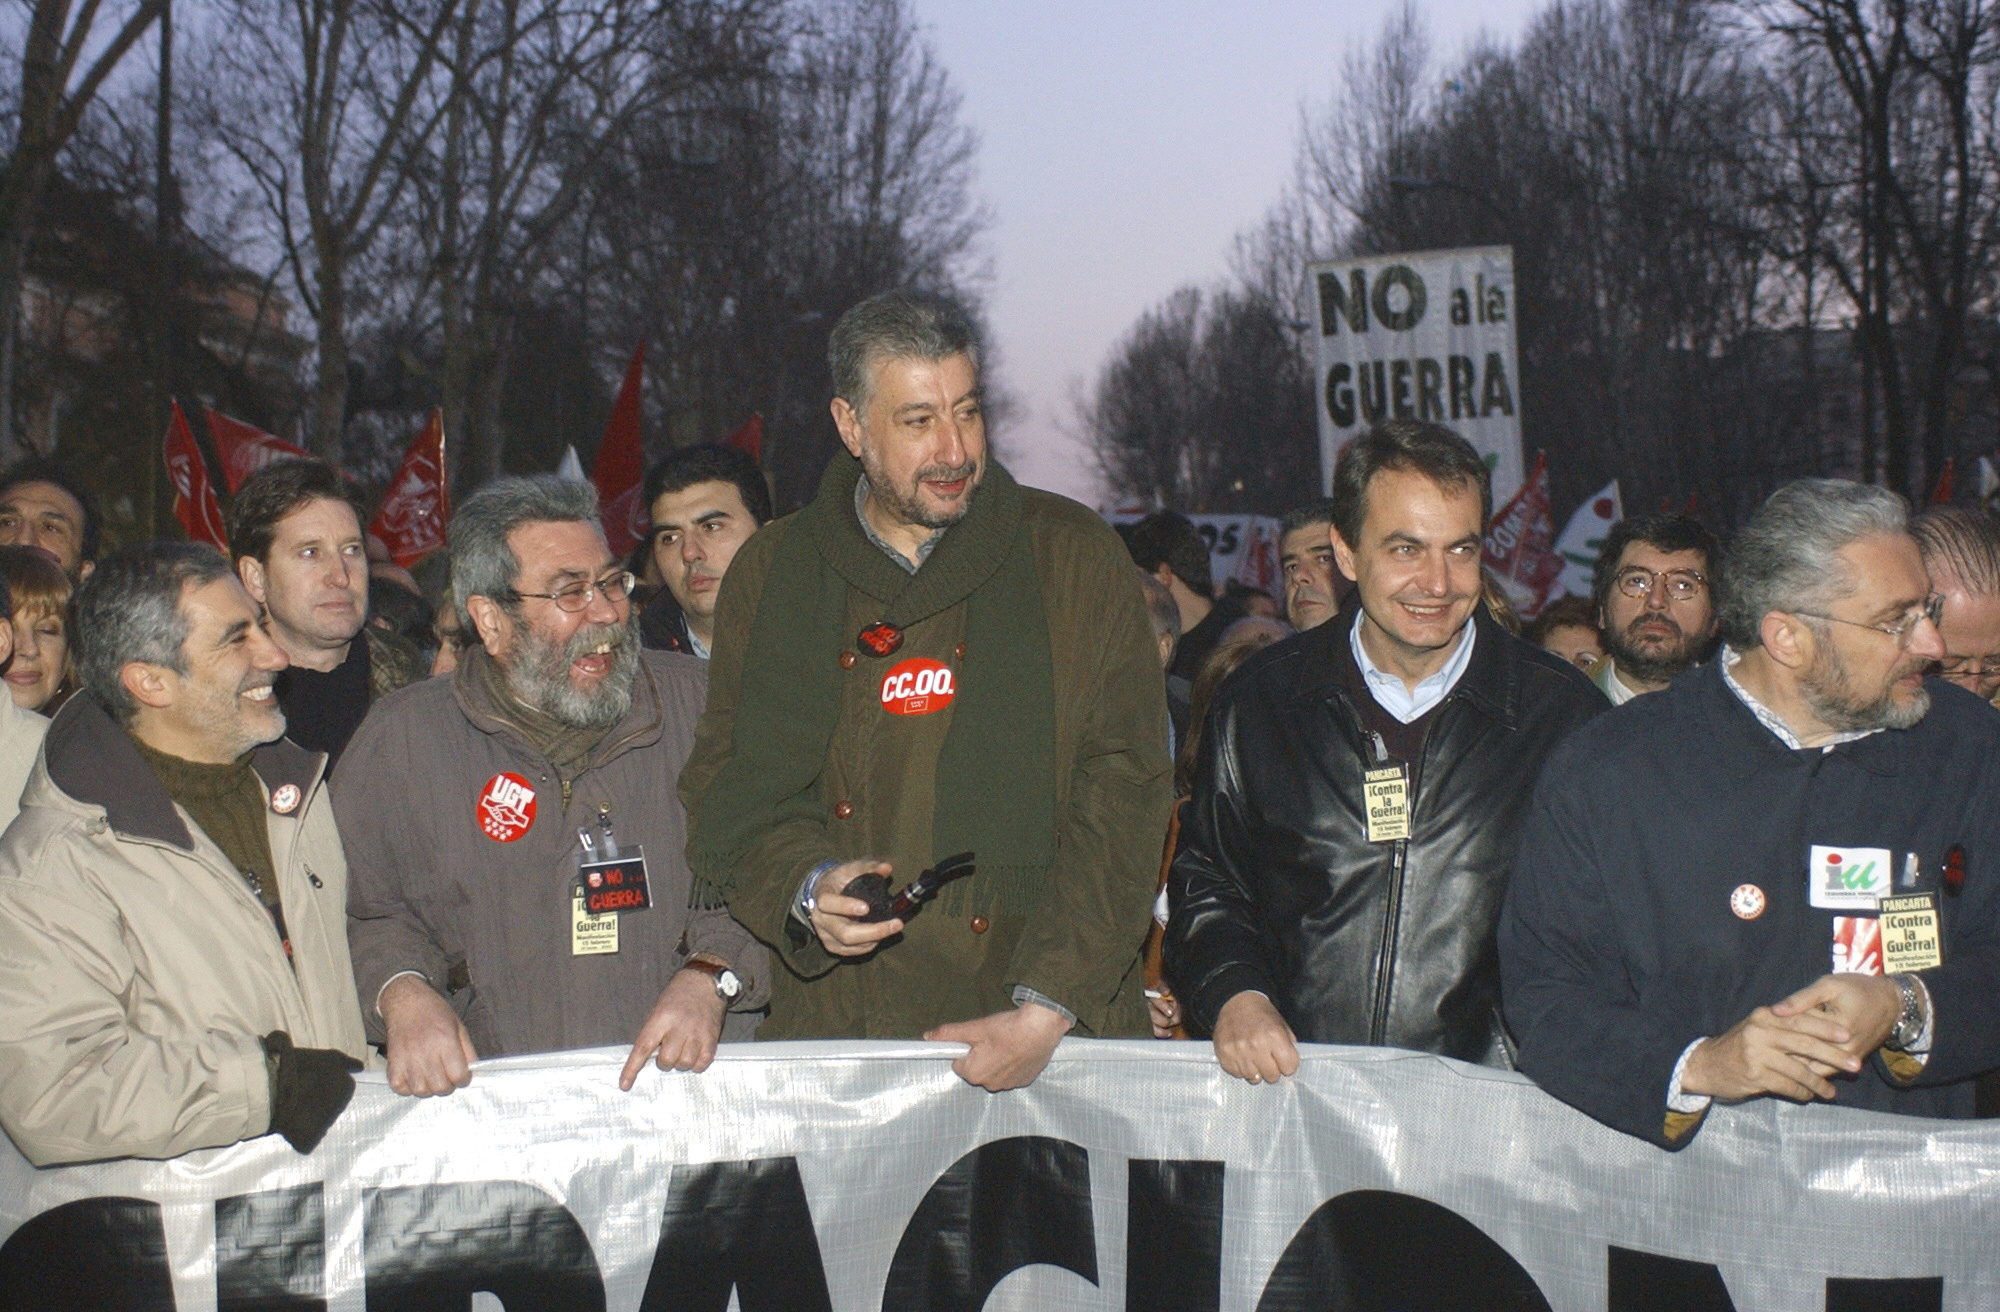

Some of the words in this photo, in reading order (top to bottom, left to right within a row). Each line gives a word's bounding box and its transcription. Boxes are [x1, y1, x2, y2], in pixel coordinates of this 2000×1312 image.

[1317, 264, 1427, 337] NO
[1450, 287, 1471, 326] a
[1474, 271, 1508, 325] la
[1325, 352, 1515, 429] GUERRA
[881, 668, 954, 703] CC.OO.
[491, 774, 536, 814] UGT
[1382, 796, 1392, 807] la
[1371, 803, 1406, 819] Guerra!
[604, 868, 624, 885] NO
[589, 889, 644, 911] GUERRA
[1882, 896, 1932, 912] PANCARTA
[576, 918, 616, 932] Guerra!
[1904, 928, 1916, 941] la
[1886, 936, 1936, 953] Guerra!
